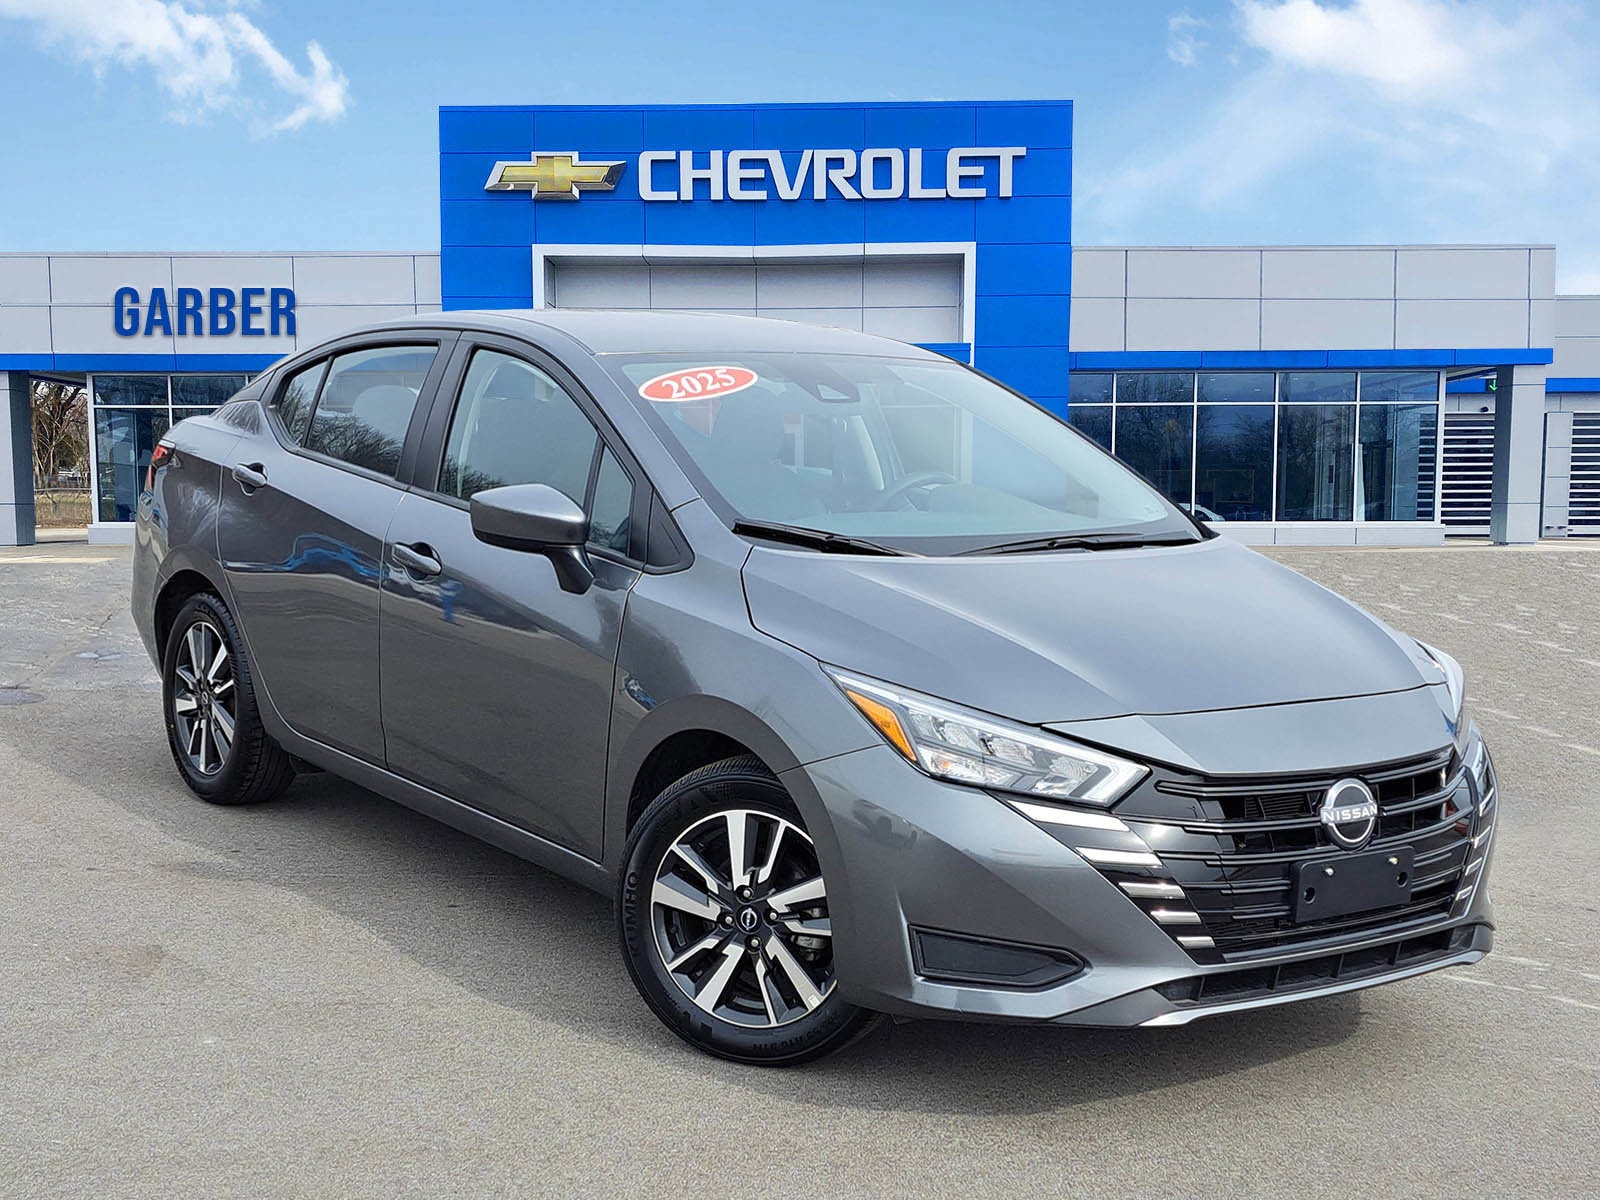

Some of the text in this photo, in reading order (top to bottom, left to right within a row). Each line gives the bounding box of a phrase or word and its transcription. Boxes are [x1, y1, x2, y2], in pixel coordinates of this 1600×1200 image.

[638, 147, 1026, 201] CHEVROLET
[114, 286, 296, 336] GARBER
[662, 368, 736, 399] 2025
[1322, 803, 1378, 822] NISSAN
